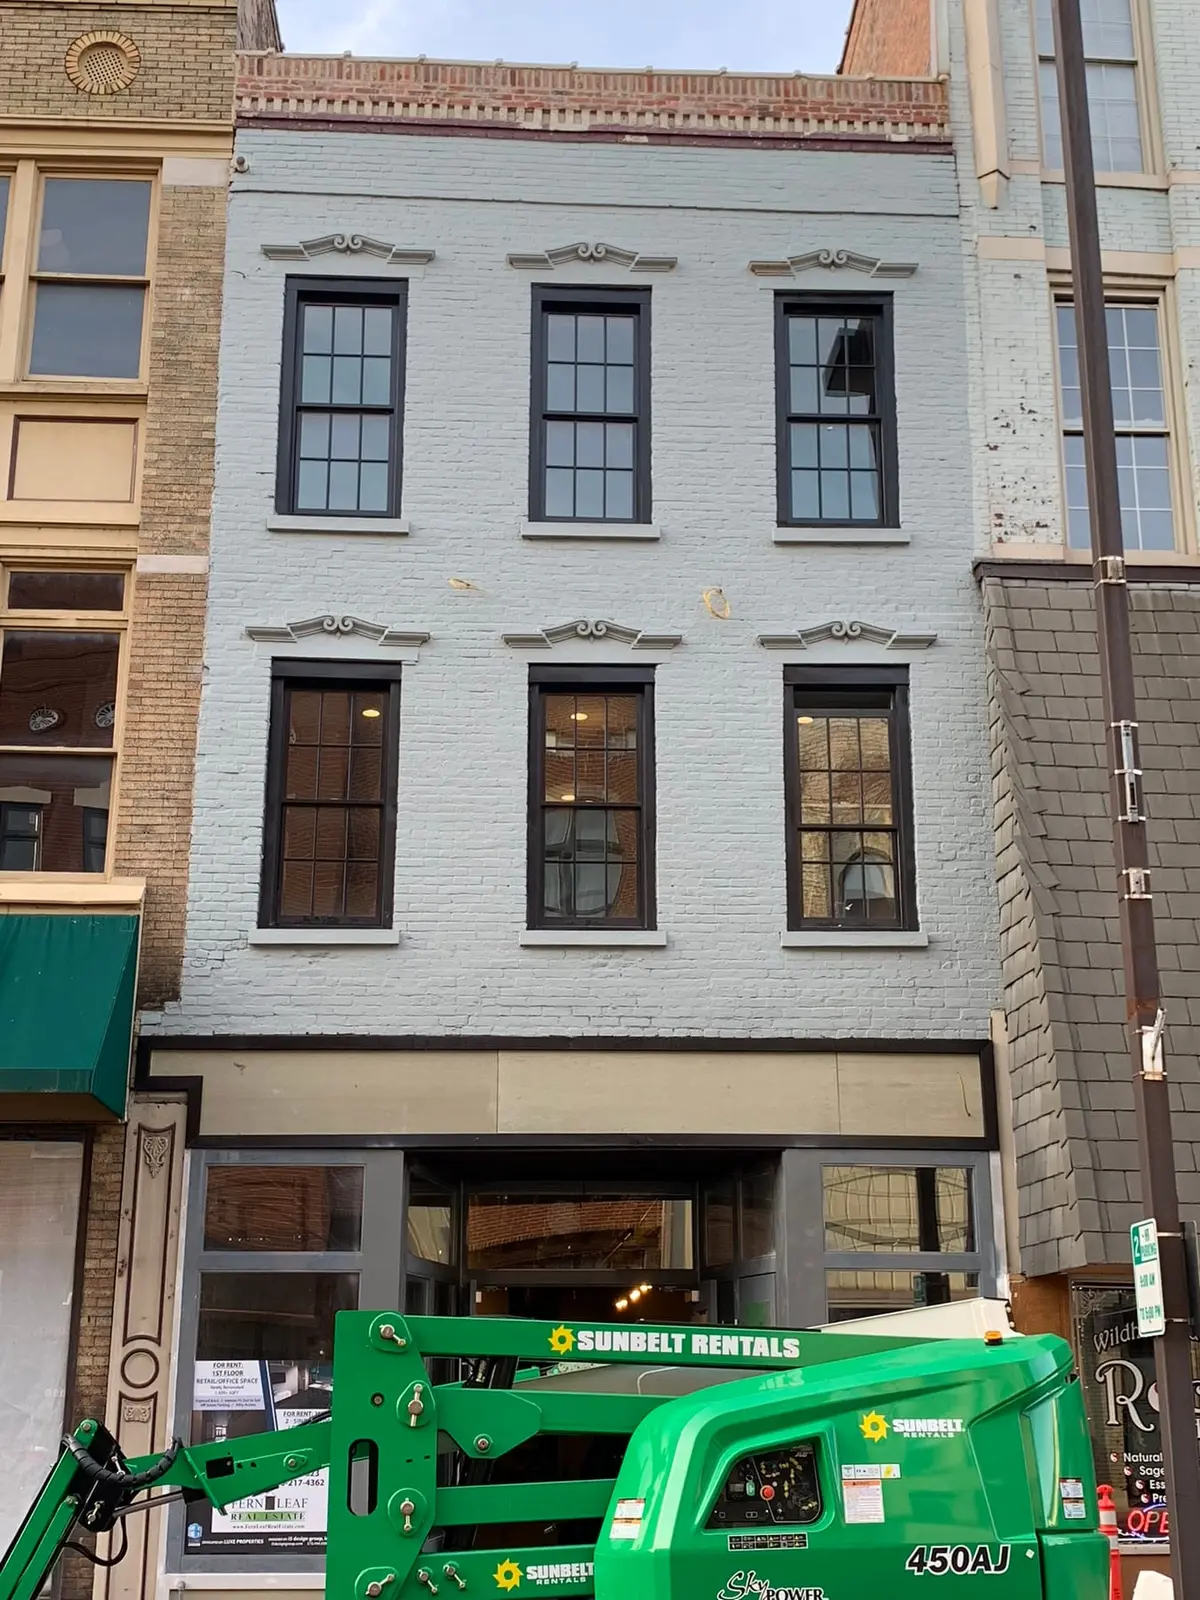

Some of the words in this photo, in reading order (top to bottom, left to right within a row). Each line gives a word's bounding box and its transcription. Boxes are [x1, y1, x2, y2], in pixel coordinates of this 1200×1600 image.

[1134, 1235, 1140, 1258] 2
[577, 1331, 686, 1354] SUNBELT
[692, 1334, 801, 1358] RENTALS
[892, 1419, 964, 1432] SUNBELT
[1123, 1453, 1163, 1463] Natural
[1140, 1466, 1165, 1477] Sage
[231, 1498, 264, 1509] FERN
[277, 1498, 309, 1509] LEAF
[905, 1544, 1011, 1575] 450AJ
[526, 1562, 595, 1580] SUNBELT
[536, 1577, 586, 1585] RENTALS
[717, 1571, 769, 1600] Sky
[765, 1587, 825, 1600] POWER
